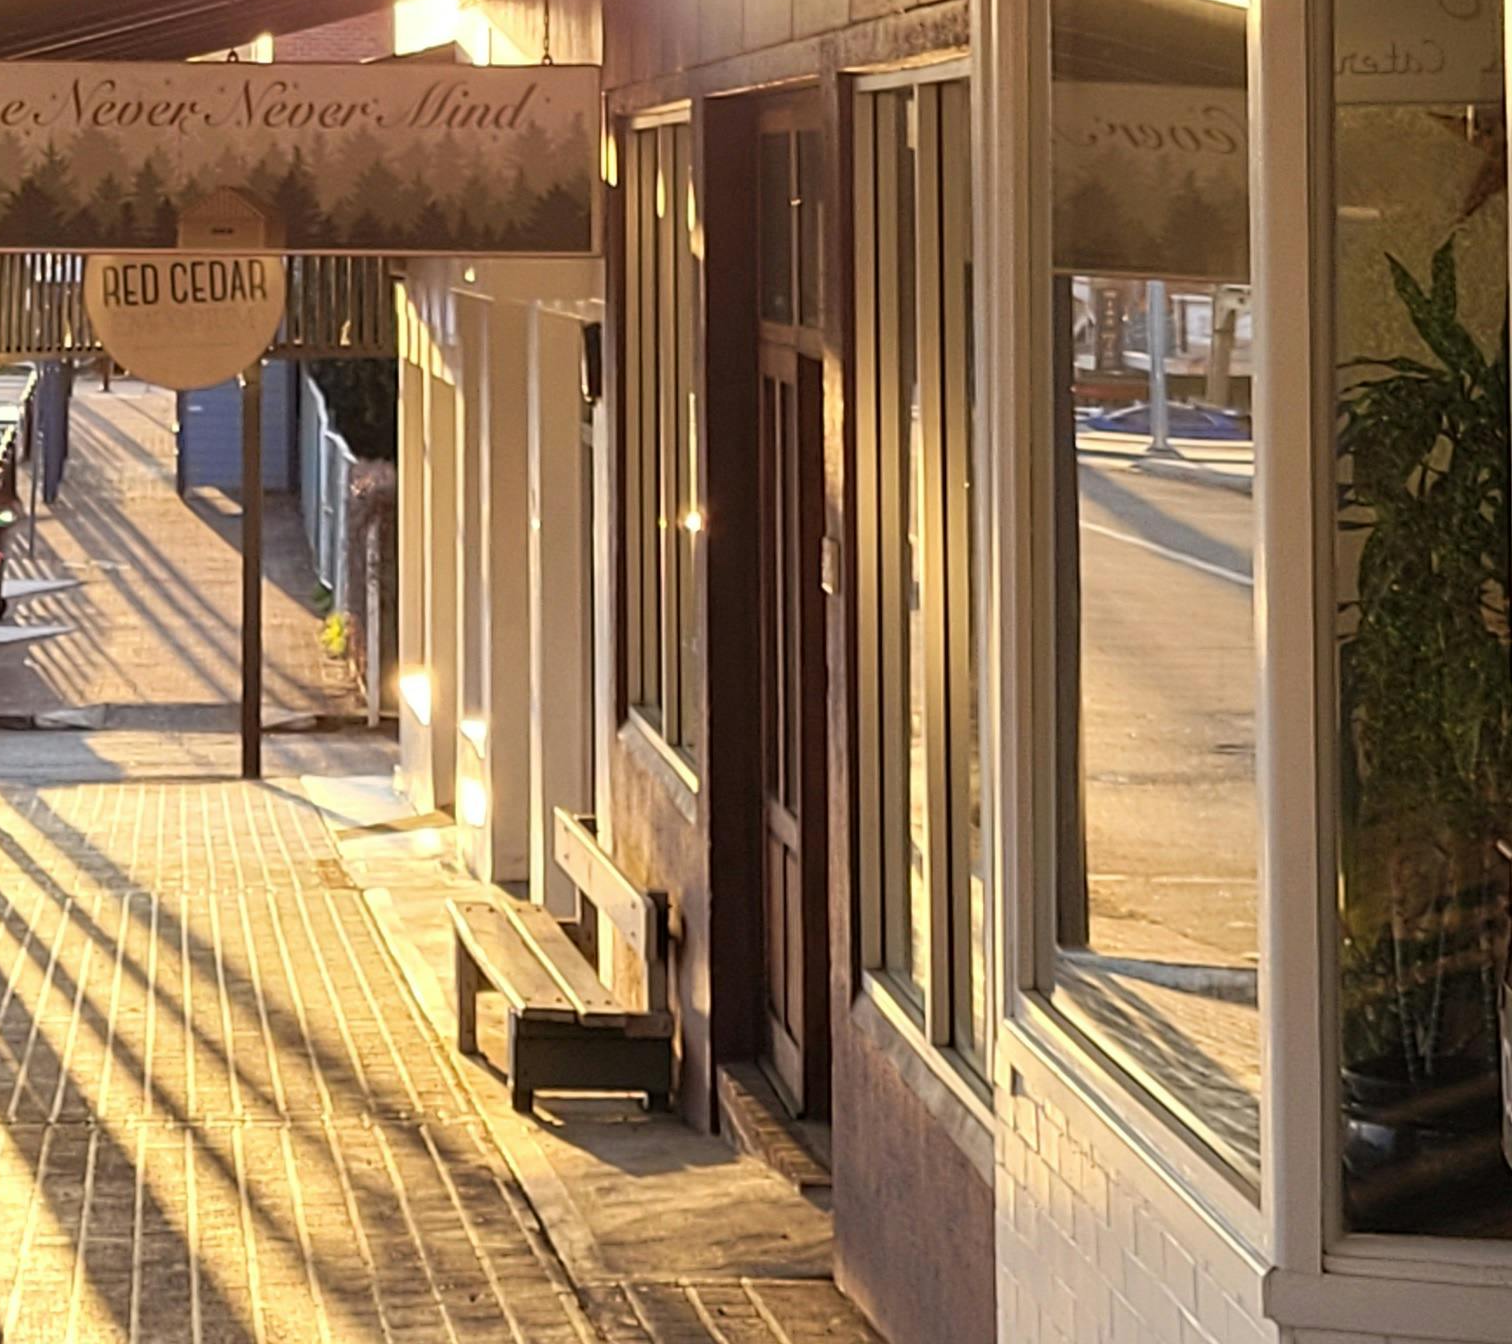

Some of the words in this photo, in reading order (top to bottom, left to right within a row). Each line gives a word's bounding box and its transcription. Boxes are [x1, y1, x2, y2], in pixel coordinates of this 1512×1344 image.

[29, 79, 202, 135] Never
[208, 78, 373, 131] Never
[376, 82, 538, 131] Mind
[102, 263, 160, 308] RED
[170, 259, 268, 305] CEDAR
